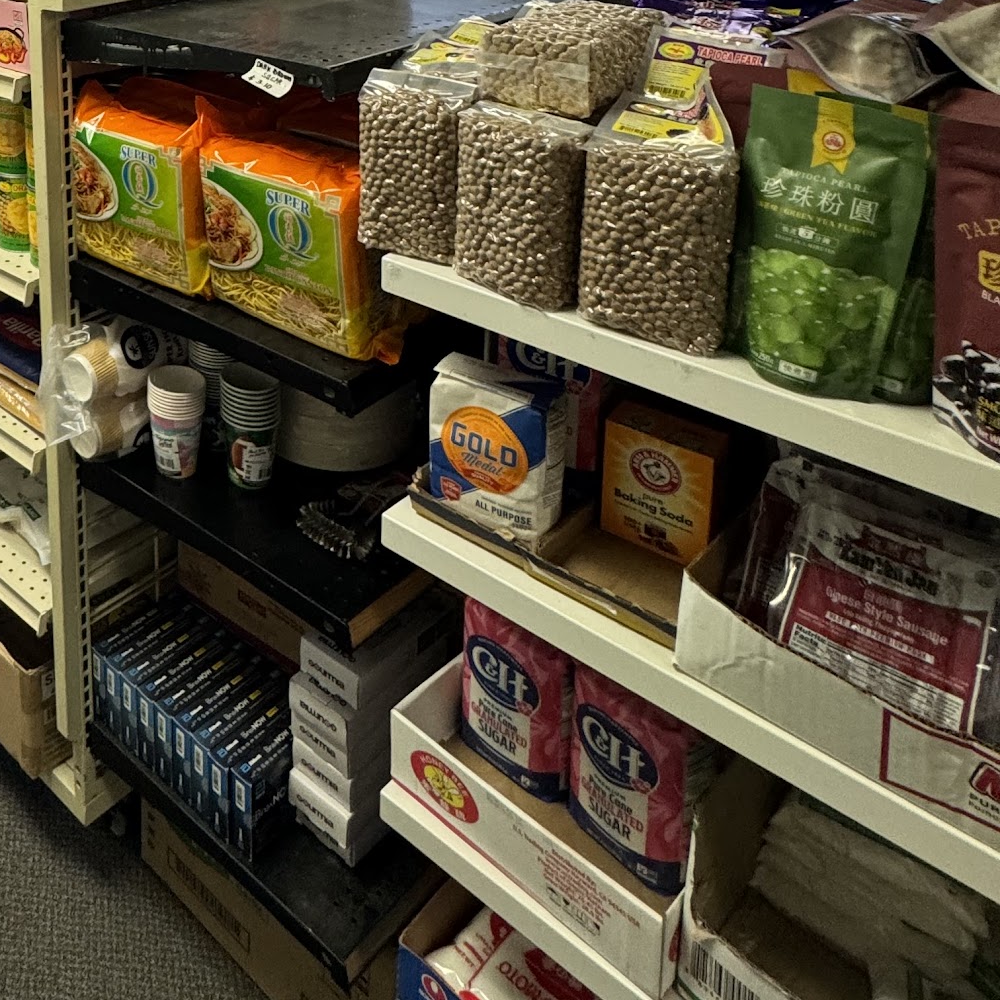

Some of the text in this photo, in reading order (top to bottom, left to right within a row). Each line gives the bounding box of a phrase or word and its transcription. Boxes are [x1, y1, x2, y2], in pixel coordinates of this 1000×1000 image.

[697, 45, 763, 67] TAPIOCA PEARL
[120, 145, 156, 168] SUPER
[121, 159, 164, 210] Q
[781, 167, 869, 194] TAPIOCA PEARL
[266, 189, 311, 218] SUPER
[760, 176, 880, 226] 珍珠粉圓
[783, 208, 813, 222] GREEN
[267, 204, 319, 262] Q
[451, 421, 518, 468] GOLD
[461, 452, 503, 476] Medal
[475, 499, 489, 512] ALL
[491, 506, 532, 526] PURPOSE
[614, 488, 657, 515] Baking
[659, 507, 694, 528] Soda
[643, 493, 664, 505] pure
[864, 602, 893, 626] Style
[896, 616, 949, 647] Sausage
[472, 646, 528, 702] C&H
[471, 702, 528, 749] GRANULATED
[478, 719, 517, 756] SUGAR
[498, 713, 518, 732] Cane
[582, 715, 645, 781] C&H
[581, 776, 644, 833] GRANULATED
[588, 797, 632, 841] SUGAR
[609, 793, 633, 814] Cane
